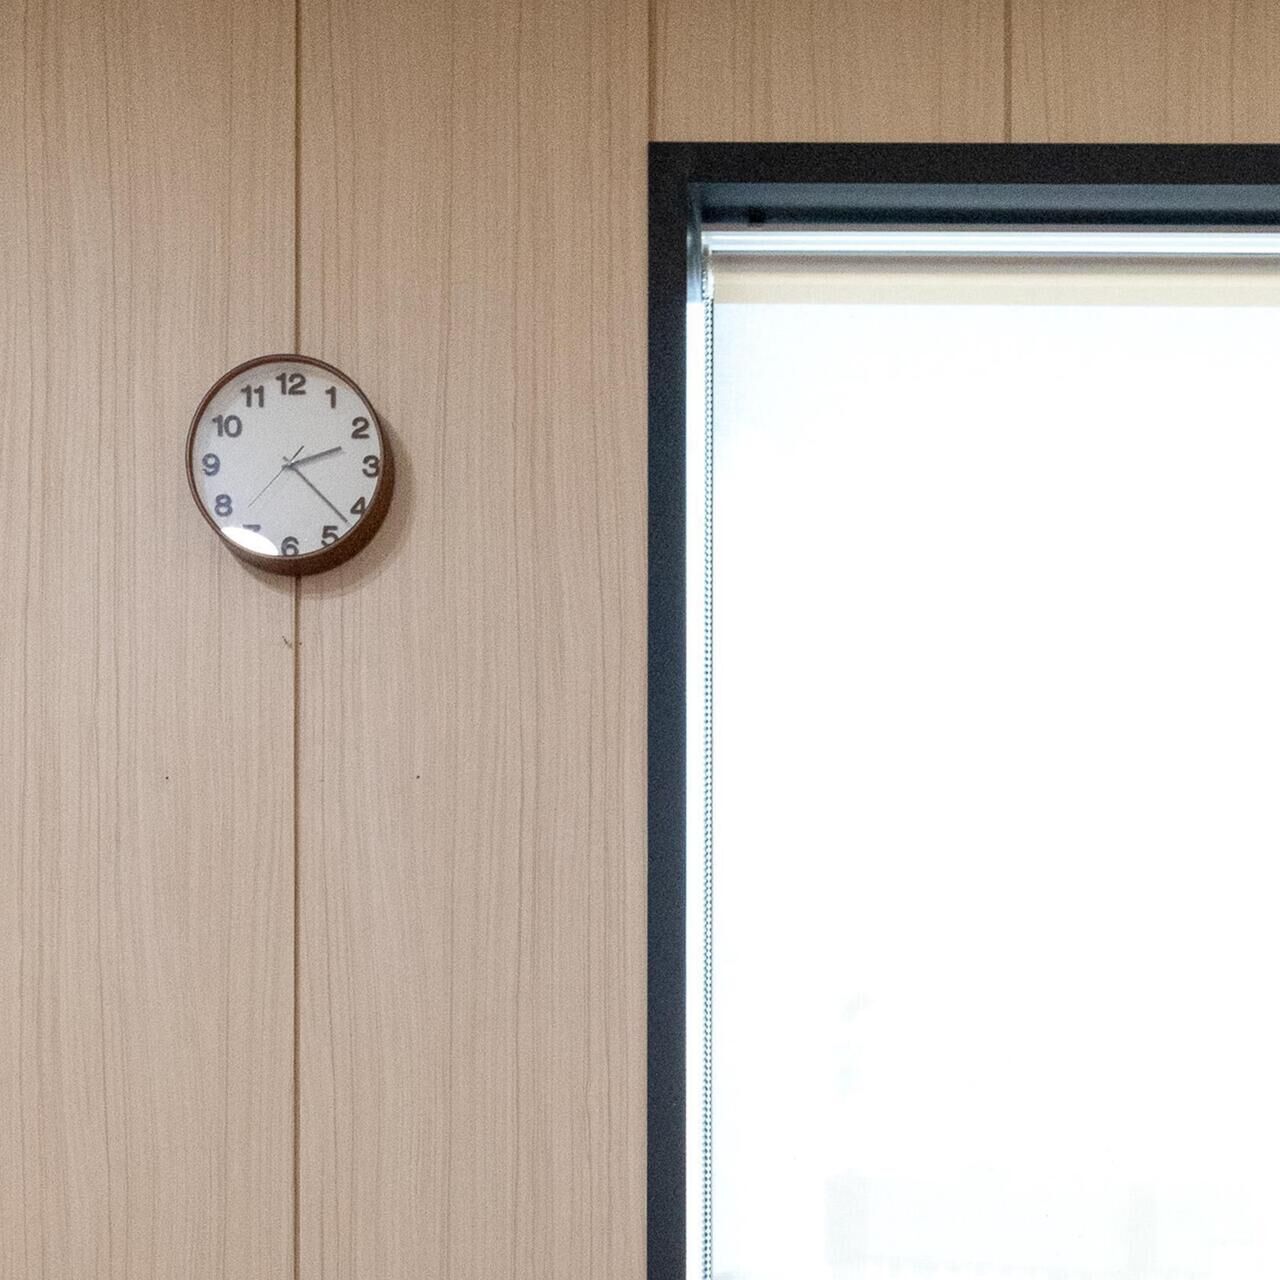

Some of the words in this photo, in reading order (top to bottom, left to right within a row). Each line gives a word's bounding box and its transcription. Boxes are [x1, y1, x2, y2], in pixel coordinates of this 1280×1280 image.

[276, 372, 306, 395] 12
[241, 385, 264, 408] 11
[325, 386, 337, 409] 1
[212, 414, 243, 438] 10
[351, 416, 370, 439] 2
[202, 453, 221, 476] 9
[362, 455, 380, 478] 3
[214, 494, 233, 517] 8
[350, 496, 368, 515] 4
[281, 536, 300, 556] 6
[321, 525, 339, 547] 5
